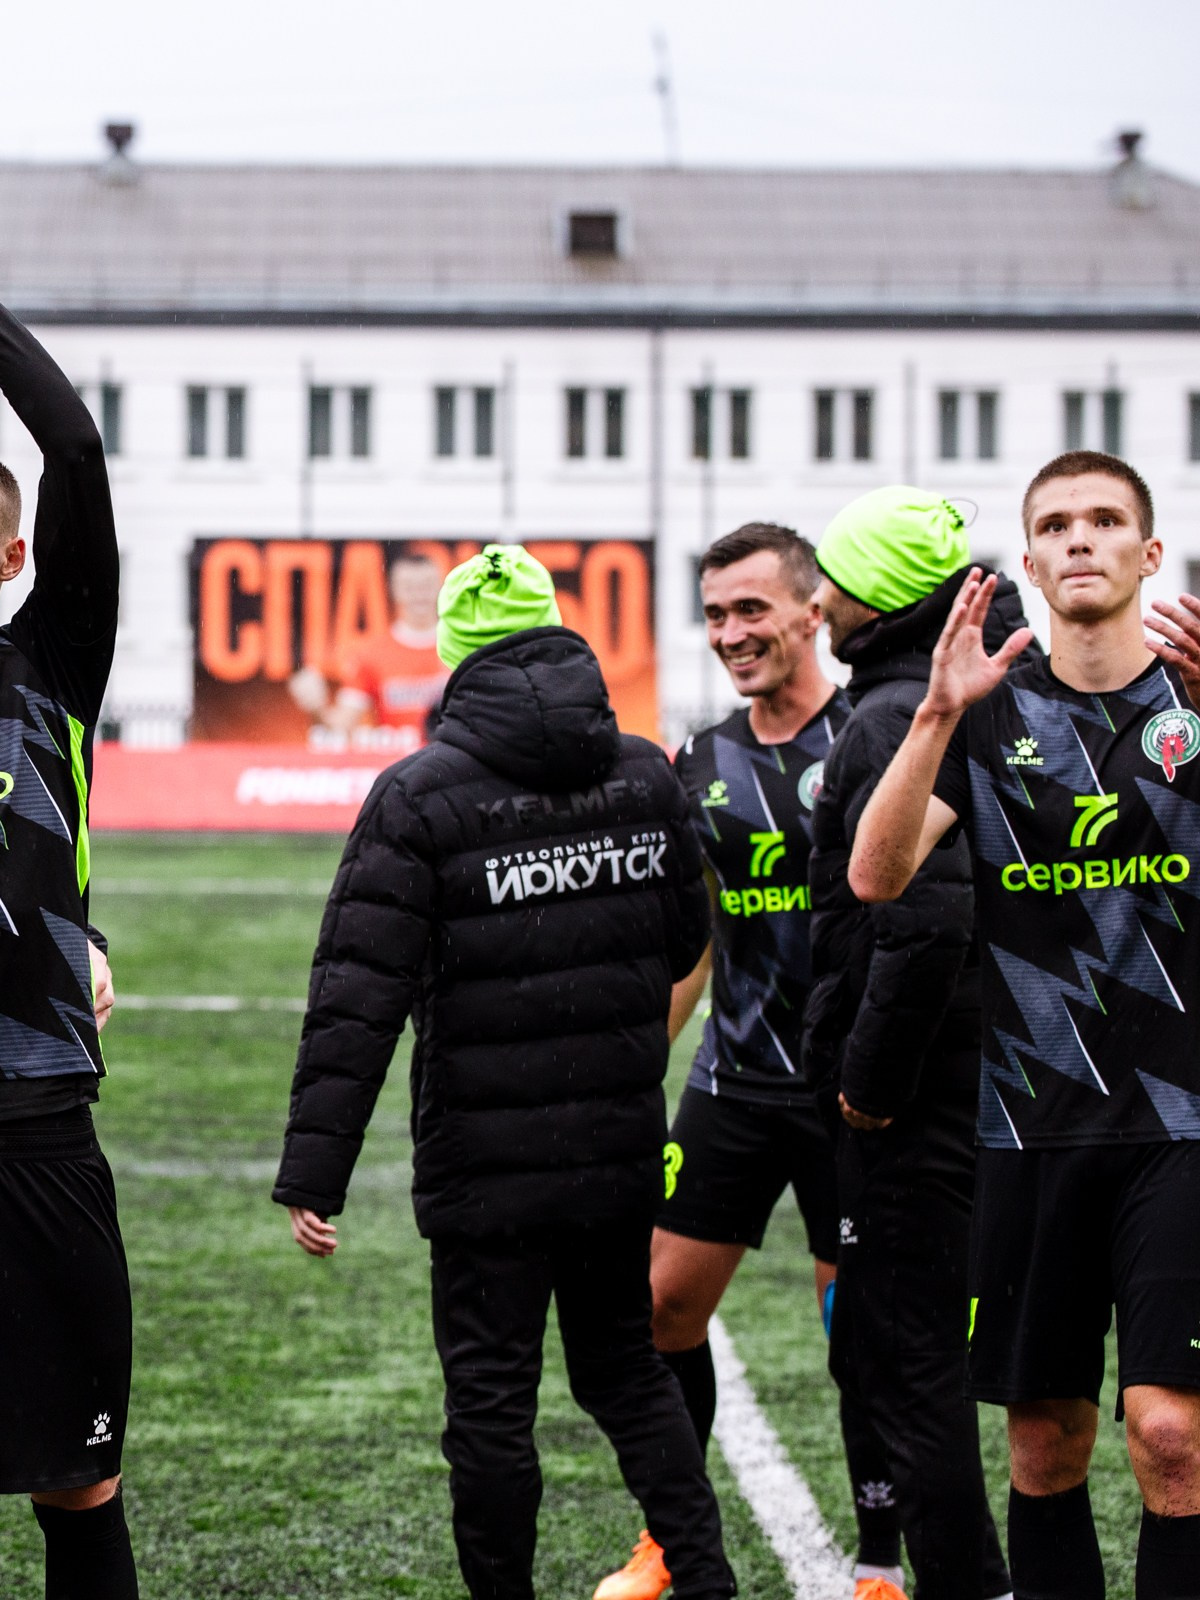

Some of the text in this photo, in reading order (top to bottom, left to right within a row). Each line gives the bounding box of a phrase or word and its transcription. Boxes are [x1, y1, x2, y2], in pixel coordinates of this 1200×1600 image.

[1006, 756, 1044, 766] KELME
[485, 830, 667, 870] ФУТБОЛЬНЫЙ КЛУБ
[1001, 854, 1191, 895] сервико
[719, 885, 812, 918] ерви
[86, 1432, 113, 1447] KELME
